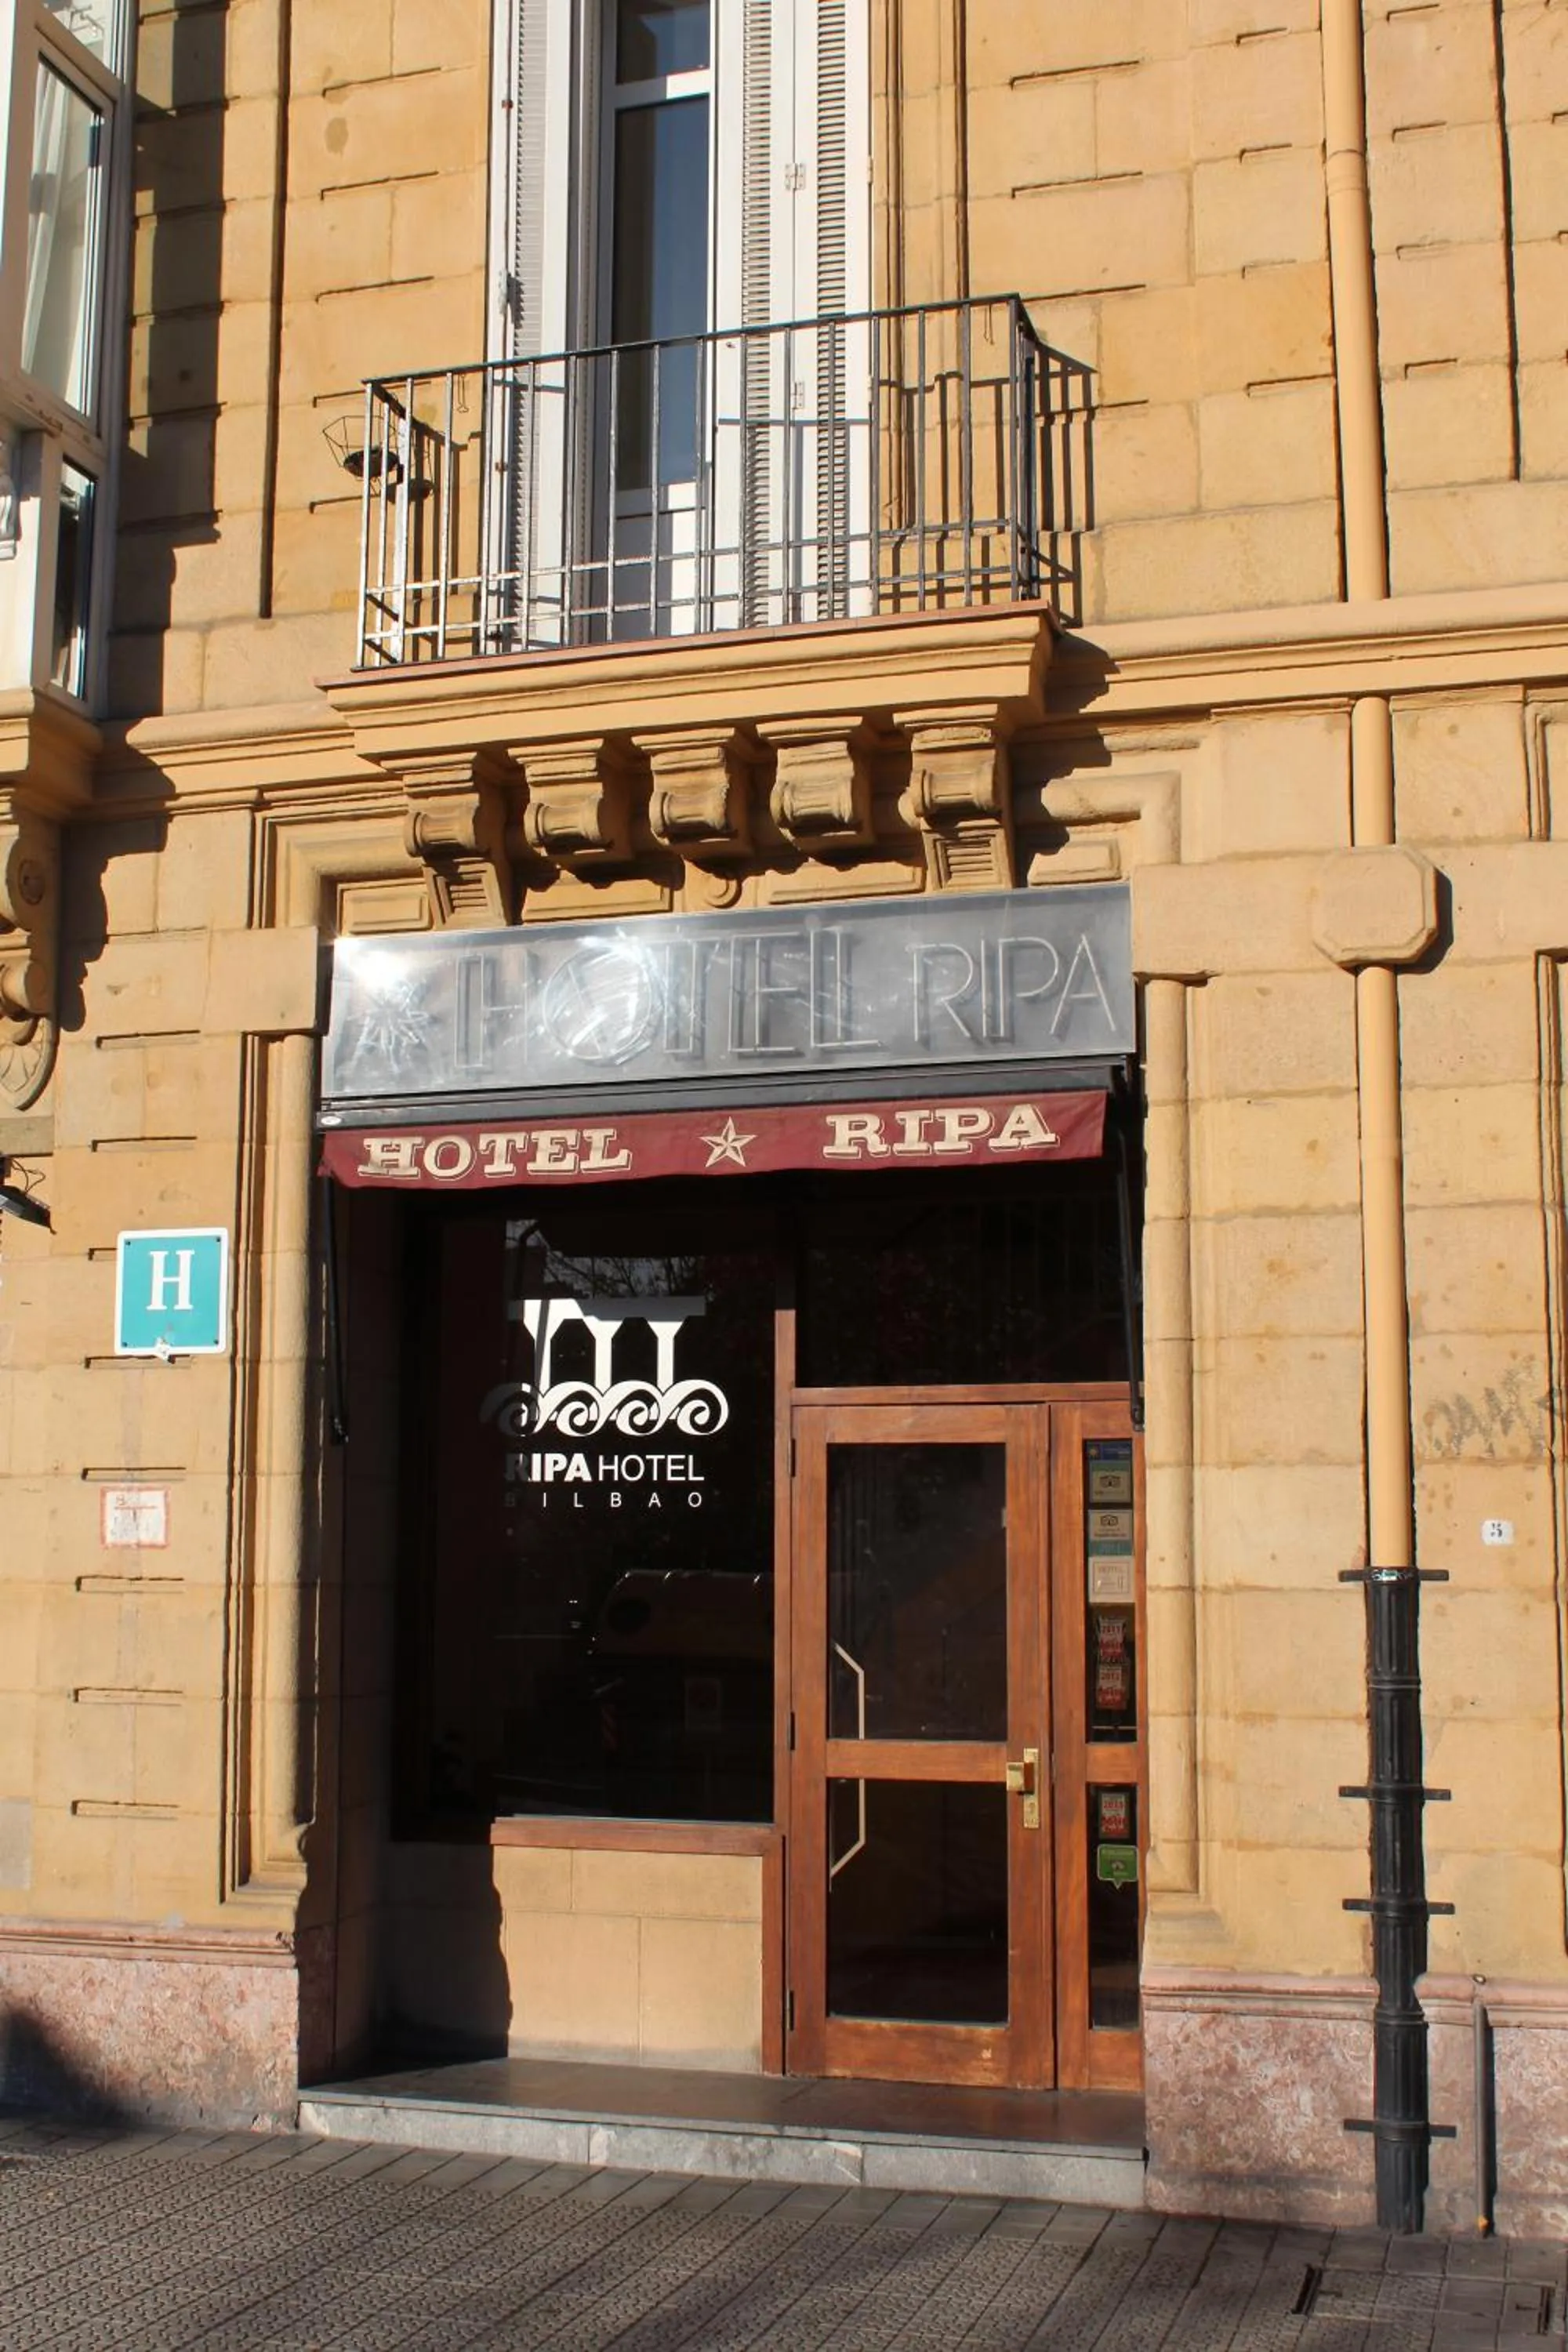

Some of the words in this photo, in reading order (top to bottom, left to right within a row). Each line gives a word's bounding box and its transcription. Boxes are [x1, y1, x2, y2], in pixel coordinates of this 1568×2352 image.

[452, 927, 884, 1068] HOTEL
[906, 932, 1117, 1042] RIPA
[357, 1128, 633, 1181] HOTEL
[822, 1103, 1061, 1160] RIPA
[146, 1249, 195, 1311] H
[505, 1453, 593, 1483] RIPA
[598, 1454, 705, 1482] HOTEL
